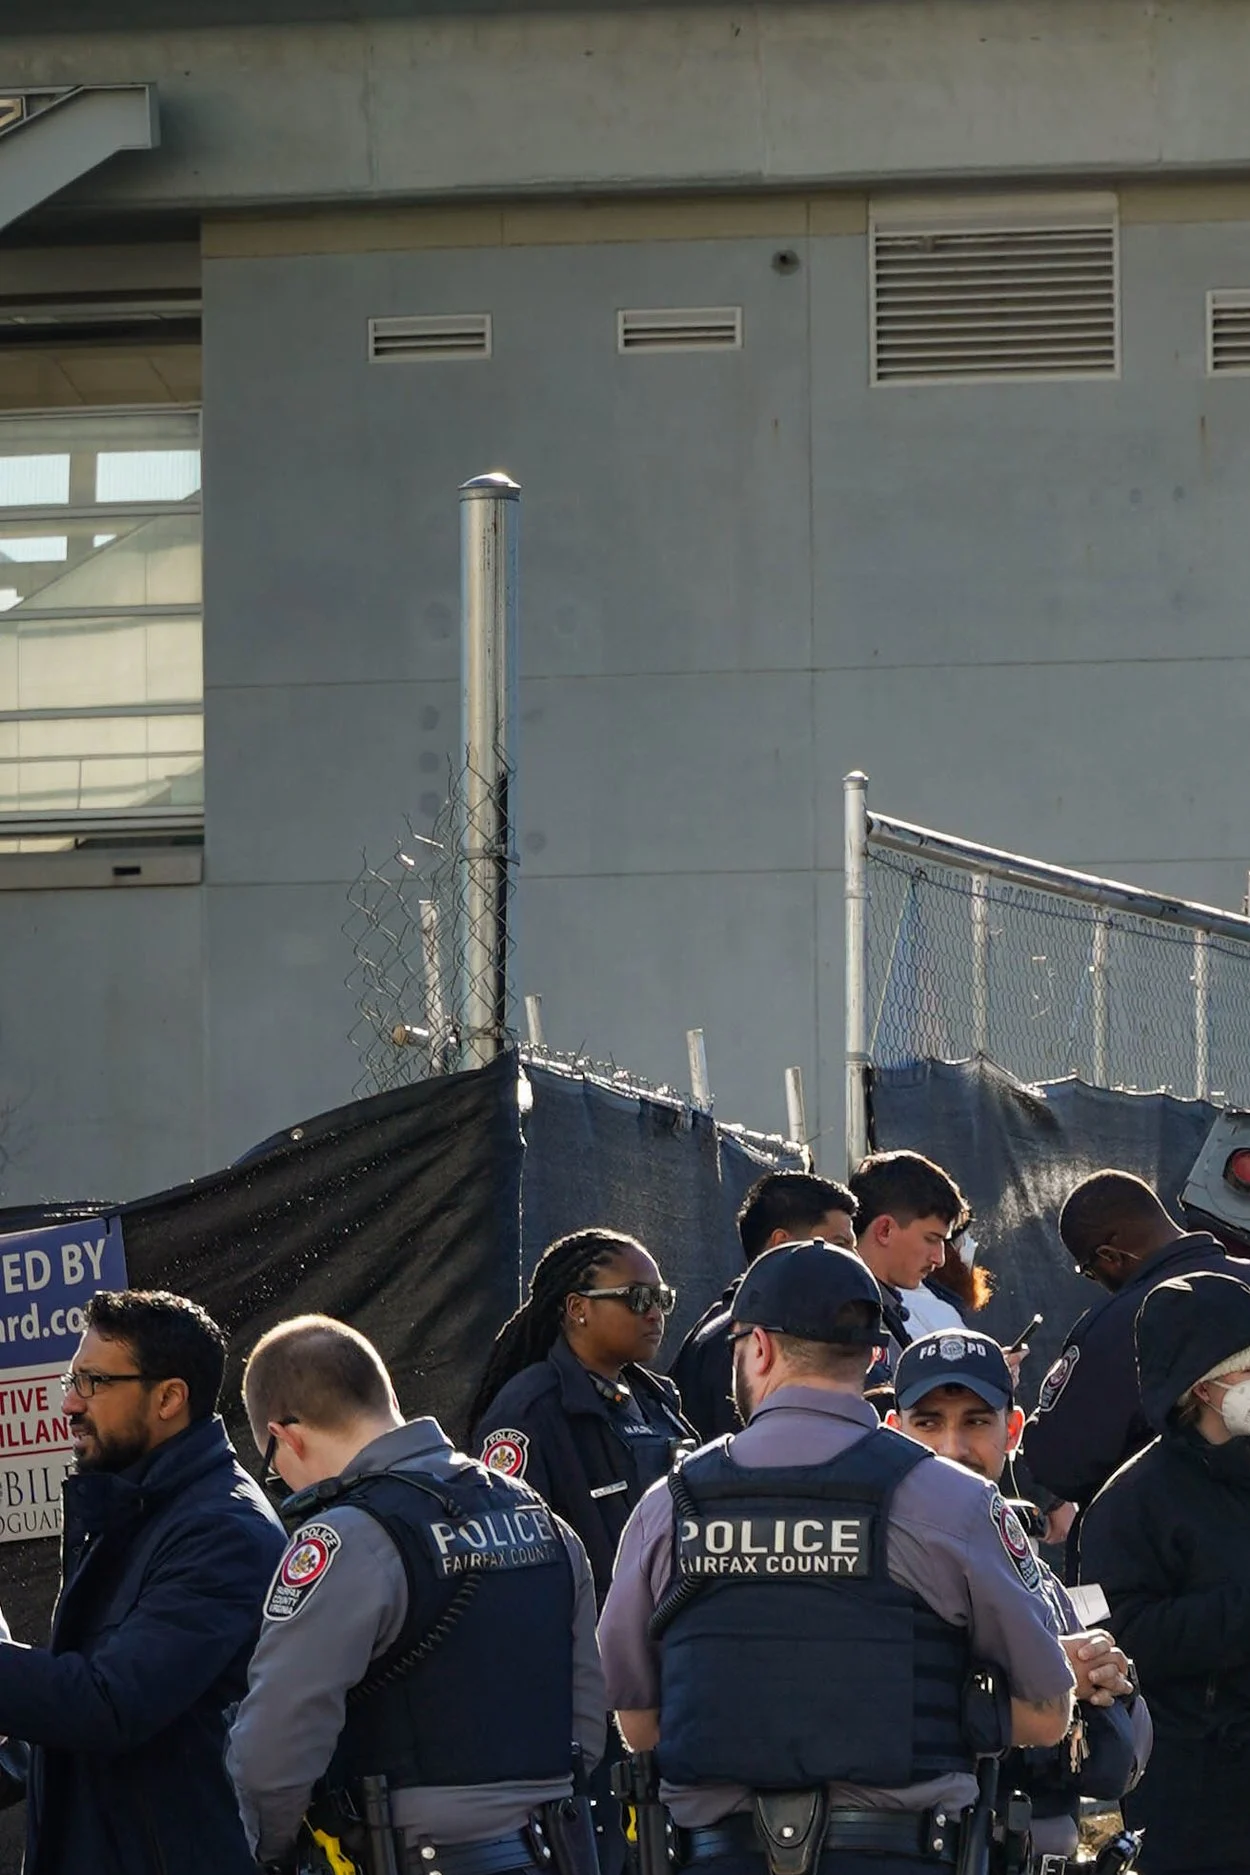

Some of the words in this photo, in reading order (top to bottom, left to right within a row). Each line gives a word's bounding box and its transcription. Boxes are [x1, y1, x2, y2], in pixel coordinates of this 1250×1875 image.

[61, 1238, 105, 1285] BY
[0, 1302, 86, 1343] rd.co
[488, 1430, 525, 1446] POLICE
[301, 1526, 338, 1549] POLICE
[430, 1510, 553, 1556] POLICE
[680, 1518, 862, 1555] POLICE
[441, 1549, 507, 1576] FAIRFAX
[510, 1543, 557, 1566] COUNT
[765, 1554, 859, 1575] COUNTY
